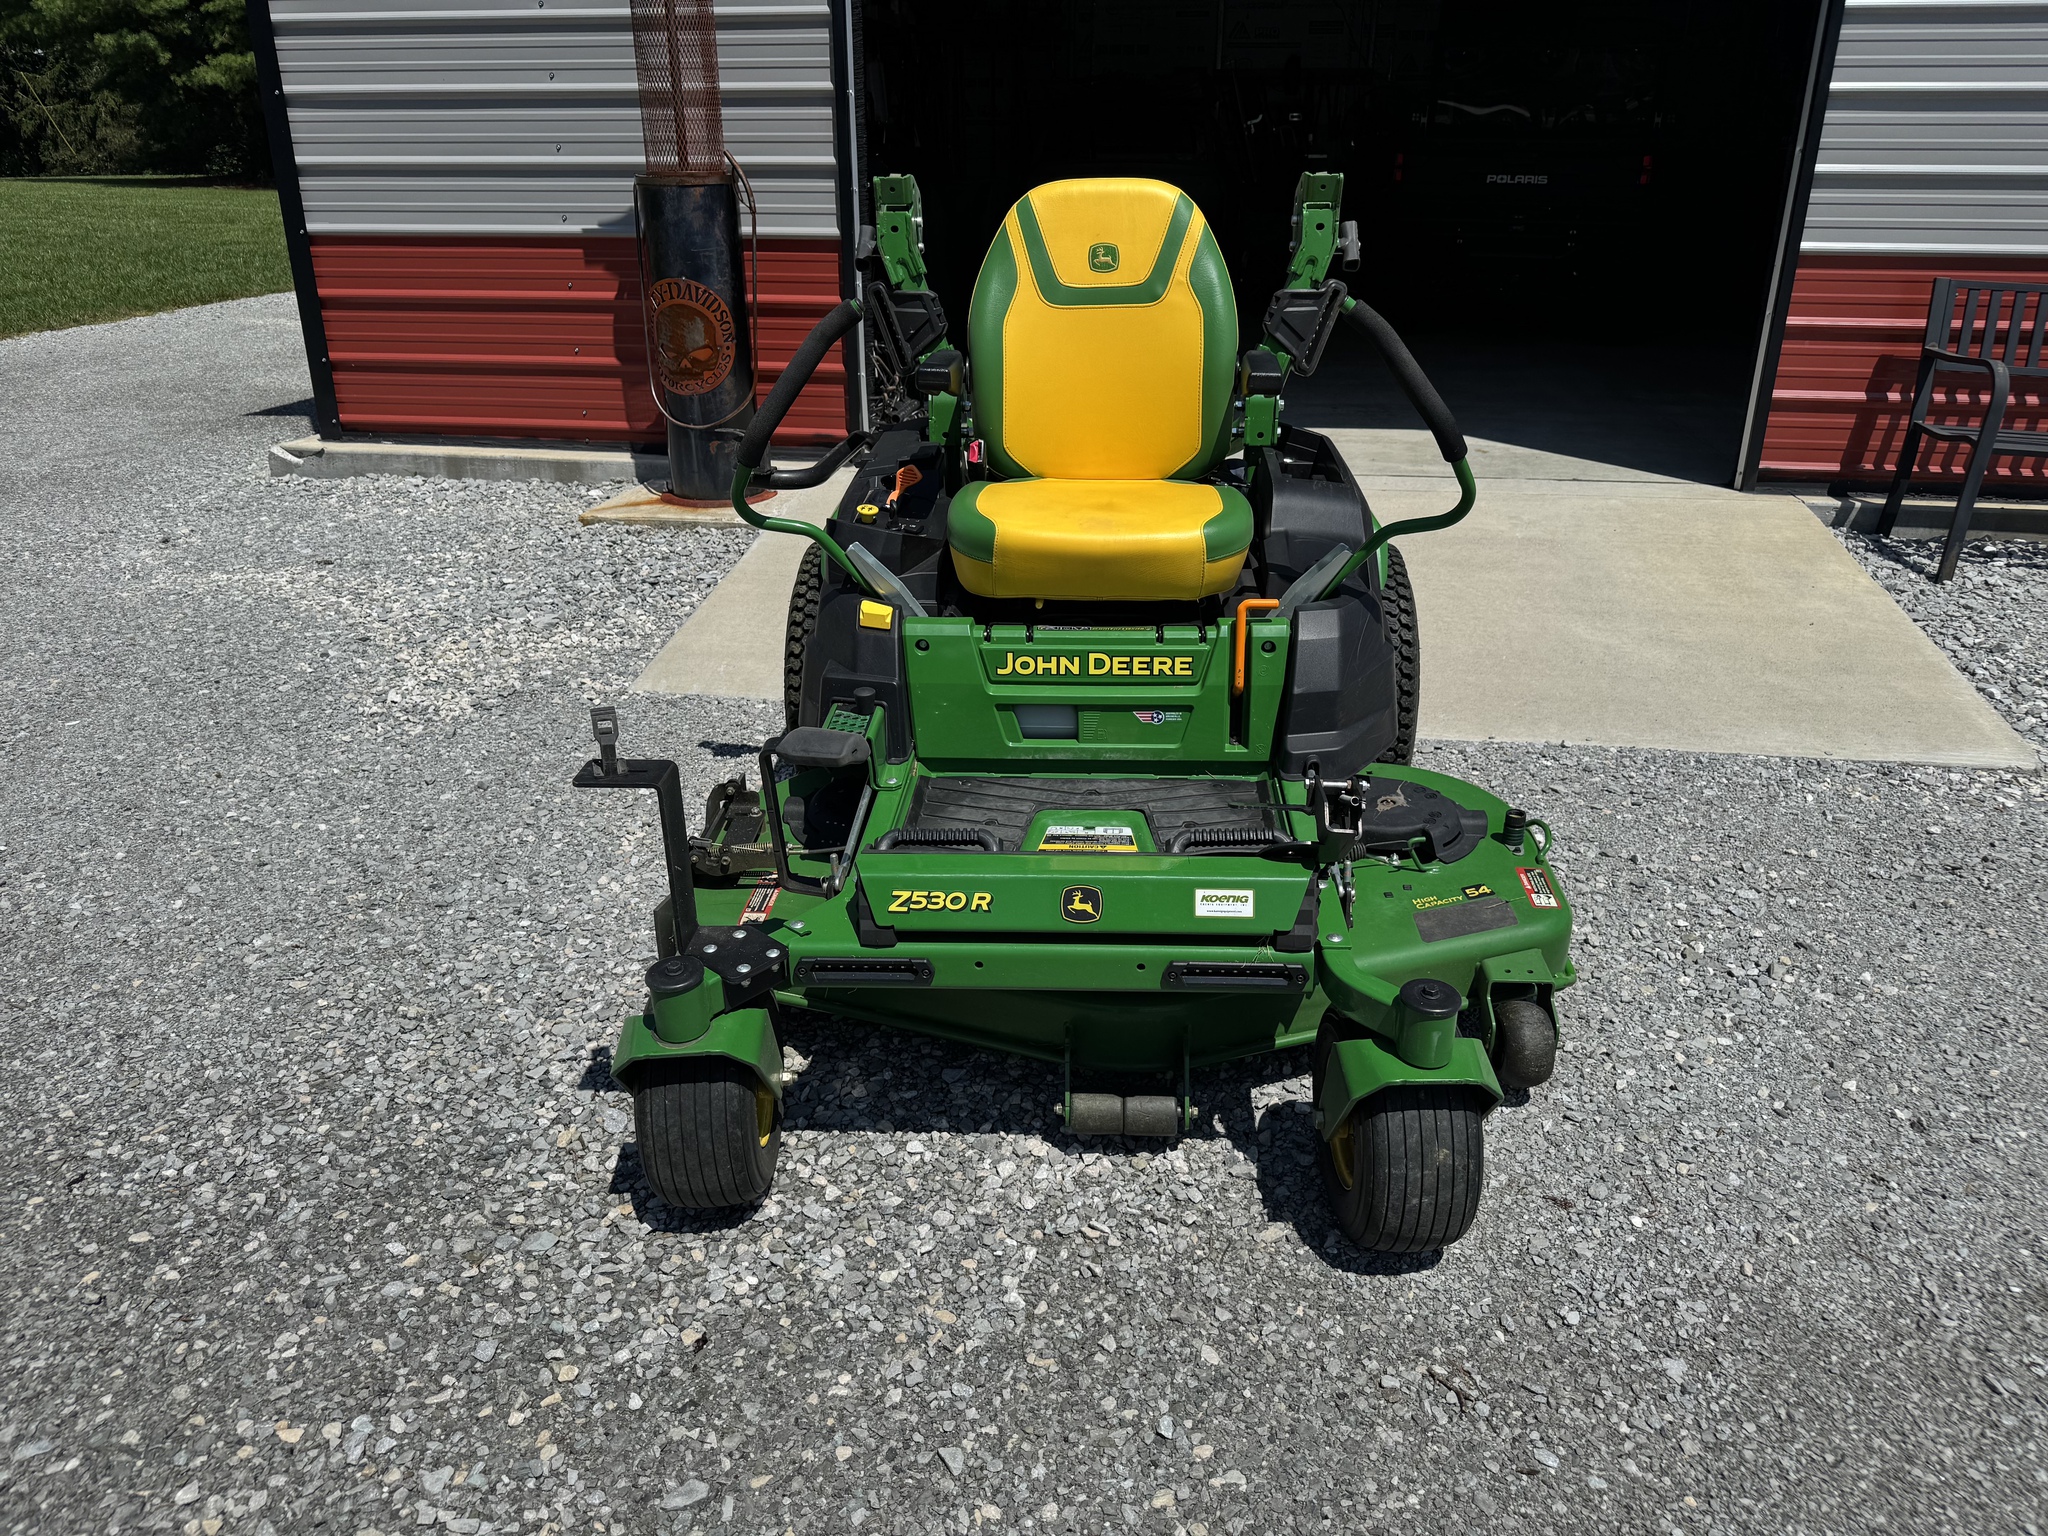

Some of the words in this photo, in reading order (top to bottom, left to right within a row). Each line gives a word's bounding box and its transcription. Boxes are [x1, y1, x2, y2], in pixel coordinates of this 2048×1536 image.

[1486, 174, 1548, 184] POLARIS
[658, 353, 732, 393] OTORCYCLES
[996, 652, 1080, 675] JOHN
[1088, 652, 1193, 676] DEERE
[1465, 885, 1492, 897] 54
[887, 890, 967, 912] Z530
[970, 892, 992, 911] R
[1412, 896, 1437, 905] HIGH
[1416, 895, 1463, 910] CAPACITY
